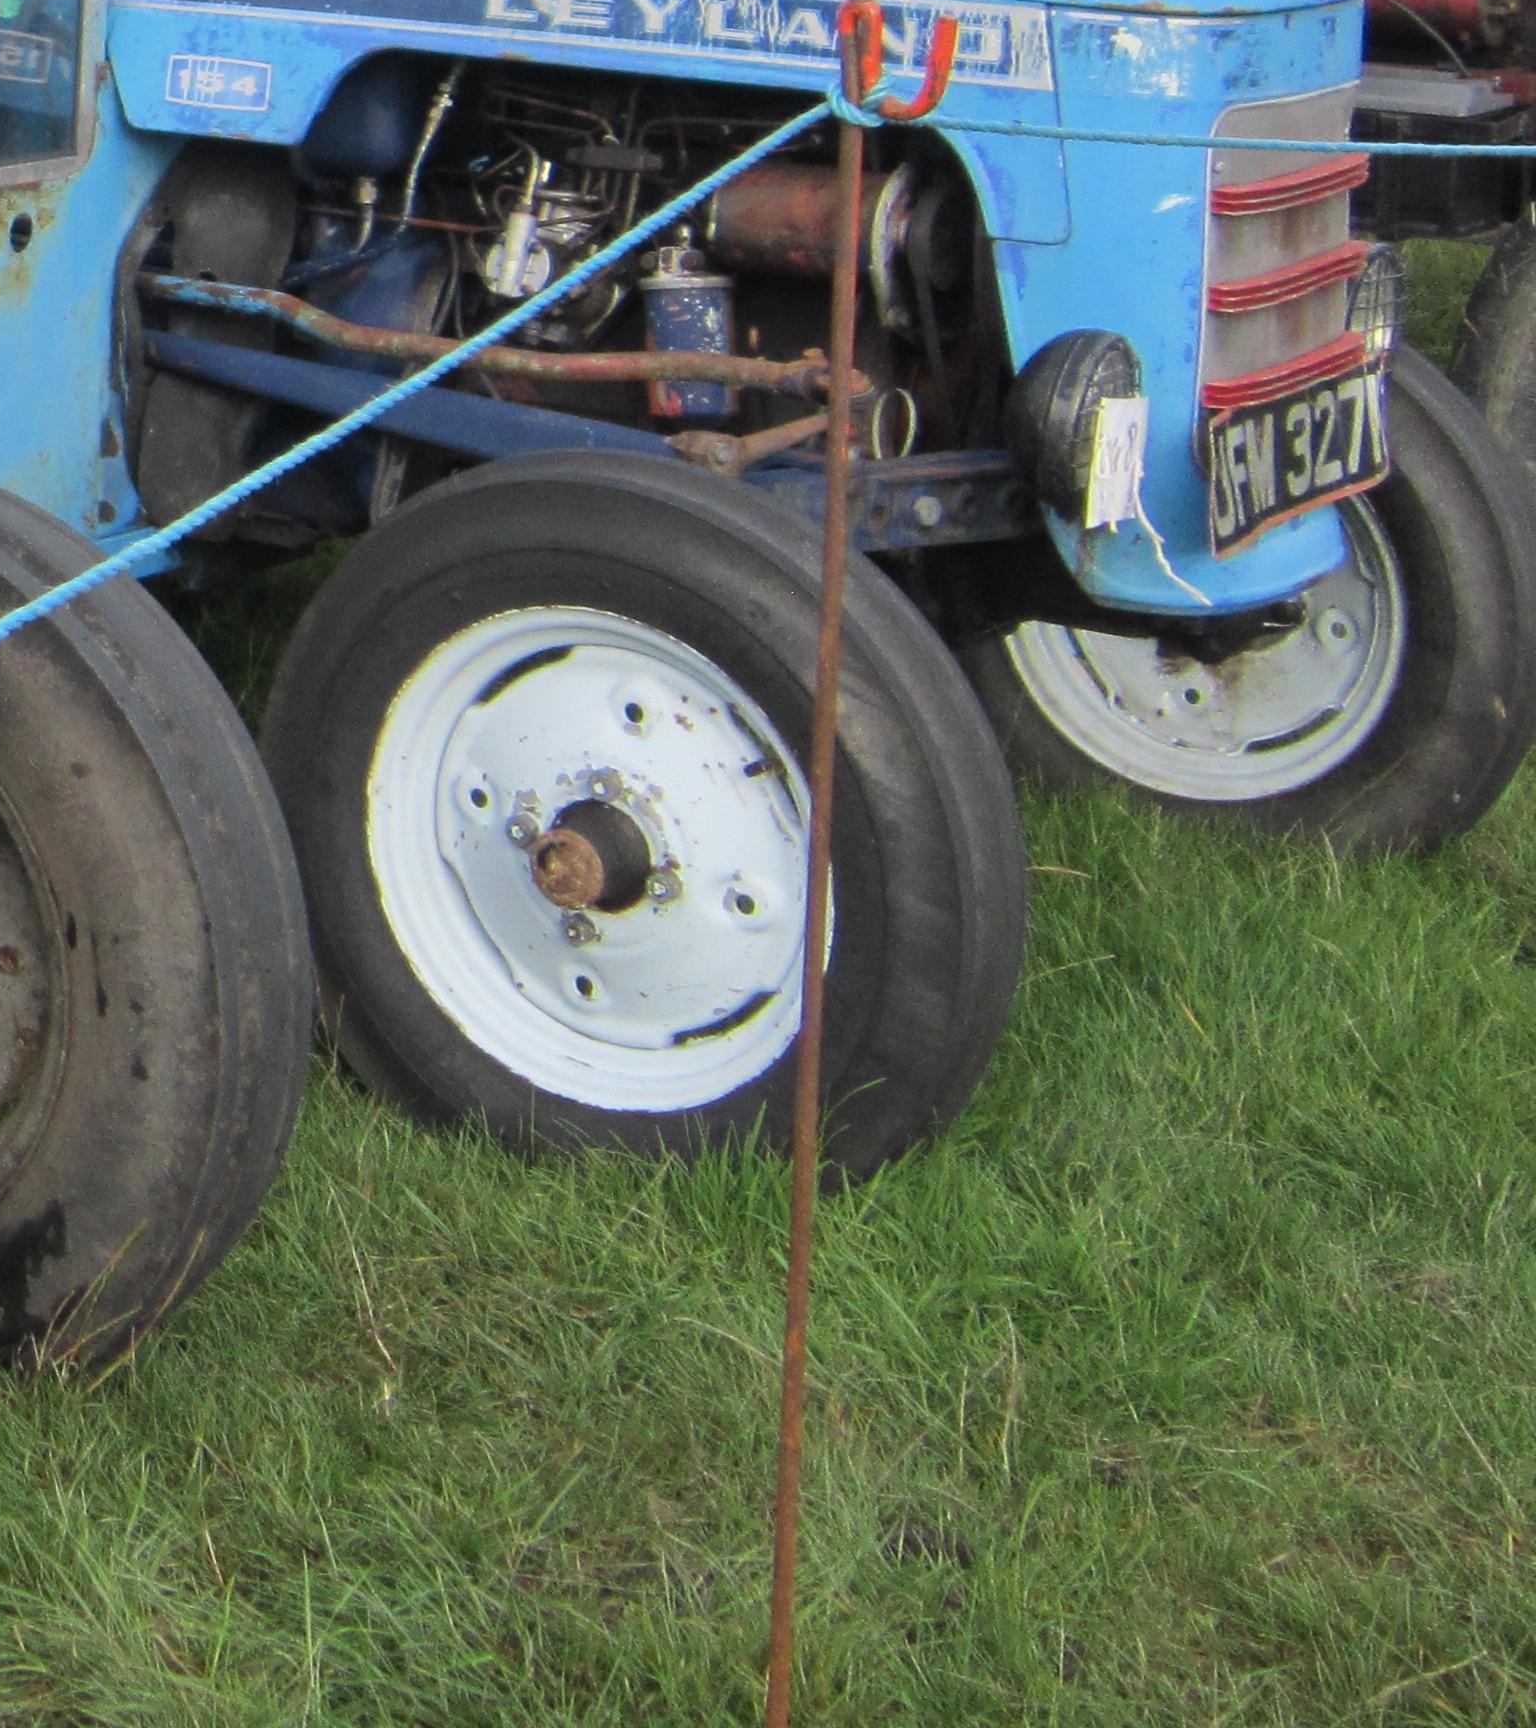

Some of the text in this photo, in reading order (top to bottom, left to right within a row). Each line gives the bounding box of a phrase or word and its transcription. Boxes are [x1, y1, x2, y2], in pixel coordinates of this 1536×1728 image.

[178, 69, 258, 97] 154
[1214, 413, 1276, 538] UFM
[1285, 373, 1383, 498] 3271
